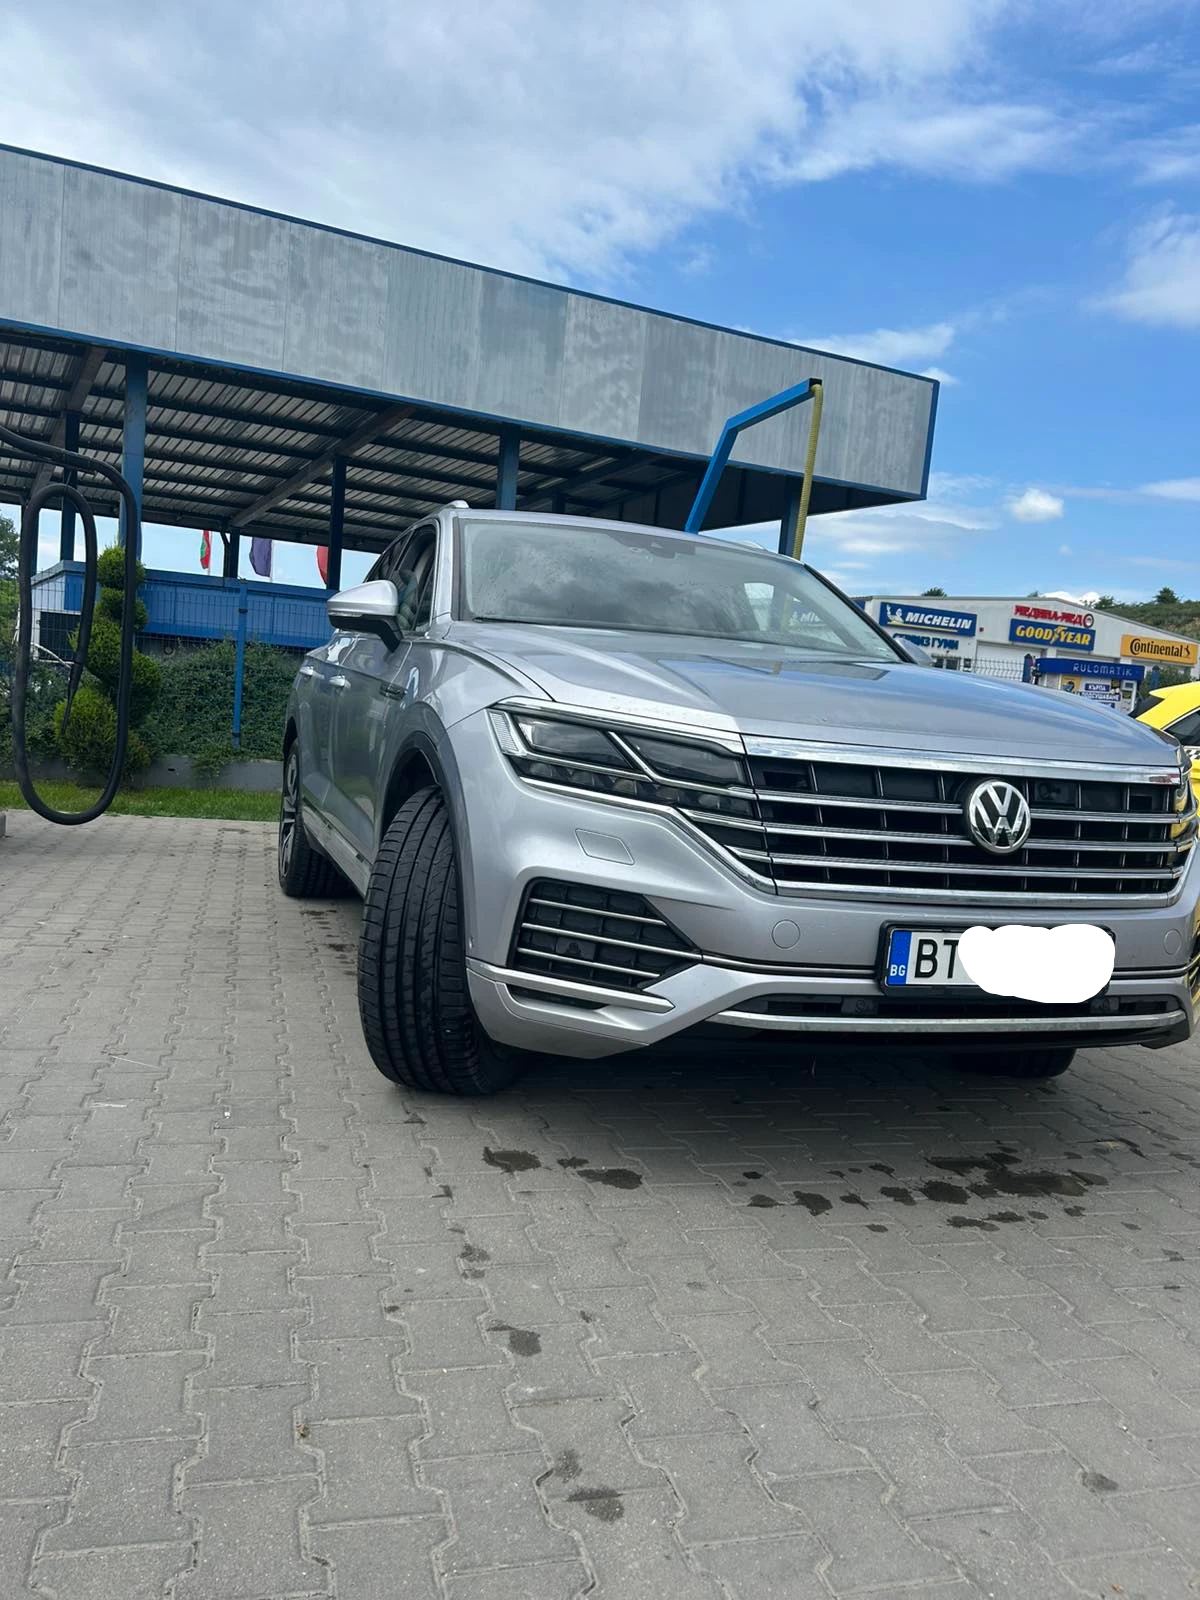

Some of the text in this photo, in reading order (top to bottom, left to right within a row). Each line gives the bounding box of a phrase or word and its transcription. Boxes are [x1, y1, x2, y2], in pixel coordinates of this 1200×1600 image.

[905, 612, 972, 629] MICHELIN
[1016, 624, 1091, 646] GOODYEAR
[1130, 638, 1183, 657] Continental
[914, 938, 960, 978] BT
[889, 964, 906, 976] BG
